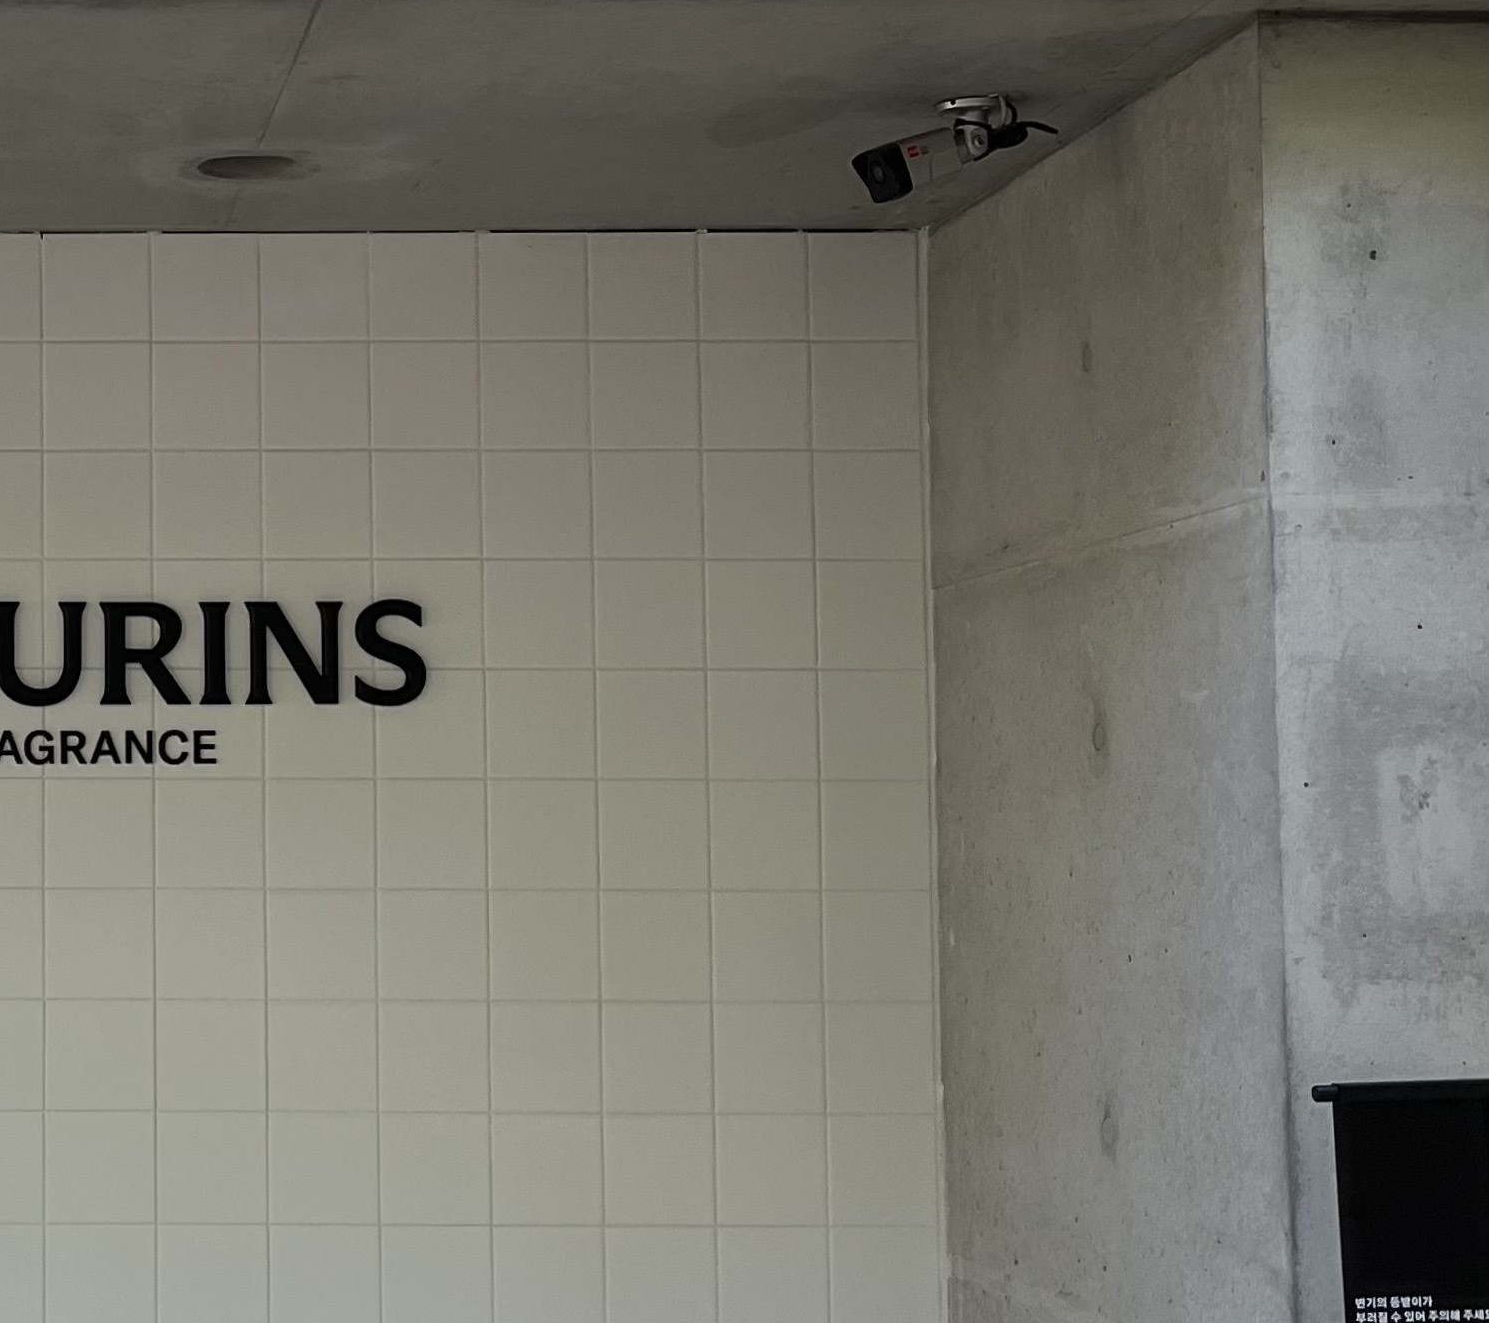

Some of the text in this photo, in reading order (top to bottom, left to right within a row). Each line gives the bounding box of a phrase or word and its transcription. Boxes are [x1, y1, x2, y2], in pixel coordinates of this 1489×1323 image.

[1355, 1296, 1388, 1309] 변기의
[1356, 1311, 1388, 1323] 부러질
[1390, 1311, 1402, 1323] 수
[1404, 1310, 1426, 1322] 있어
[1428, 1309, 1461, 1322] 주의해
